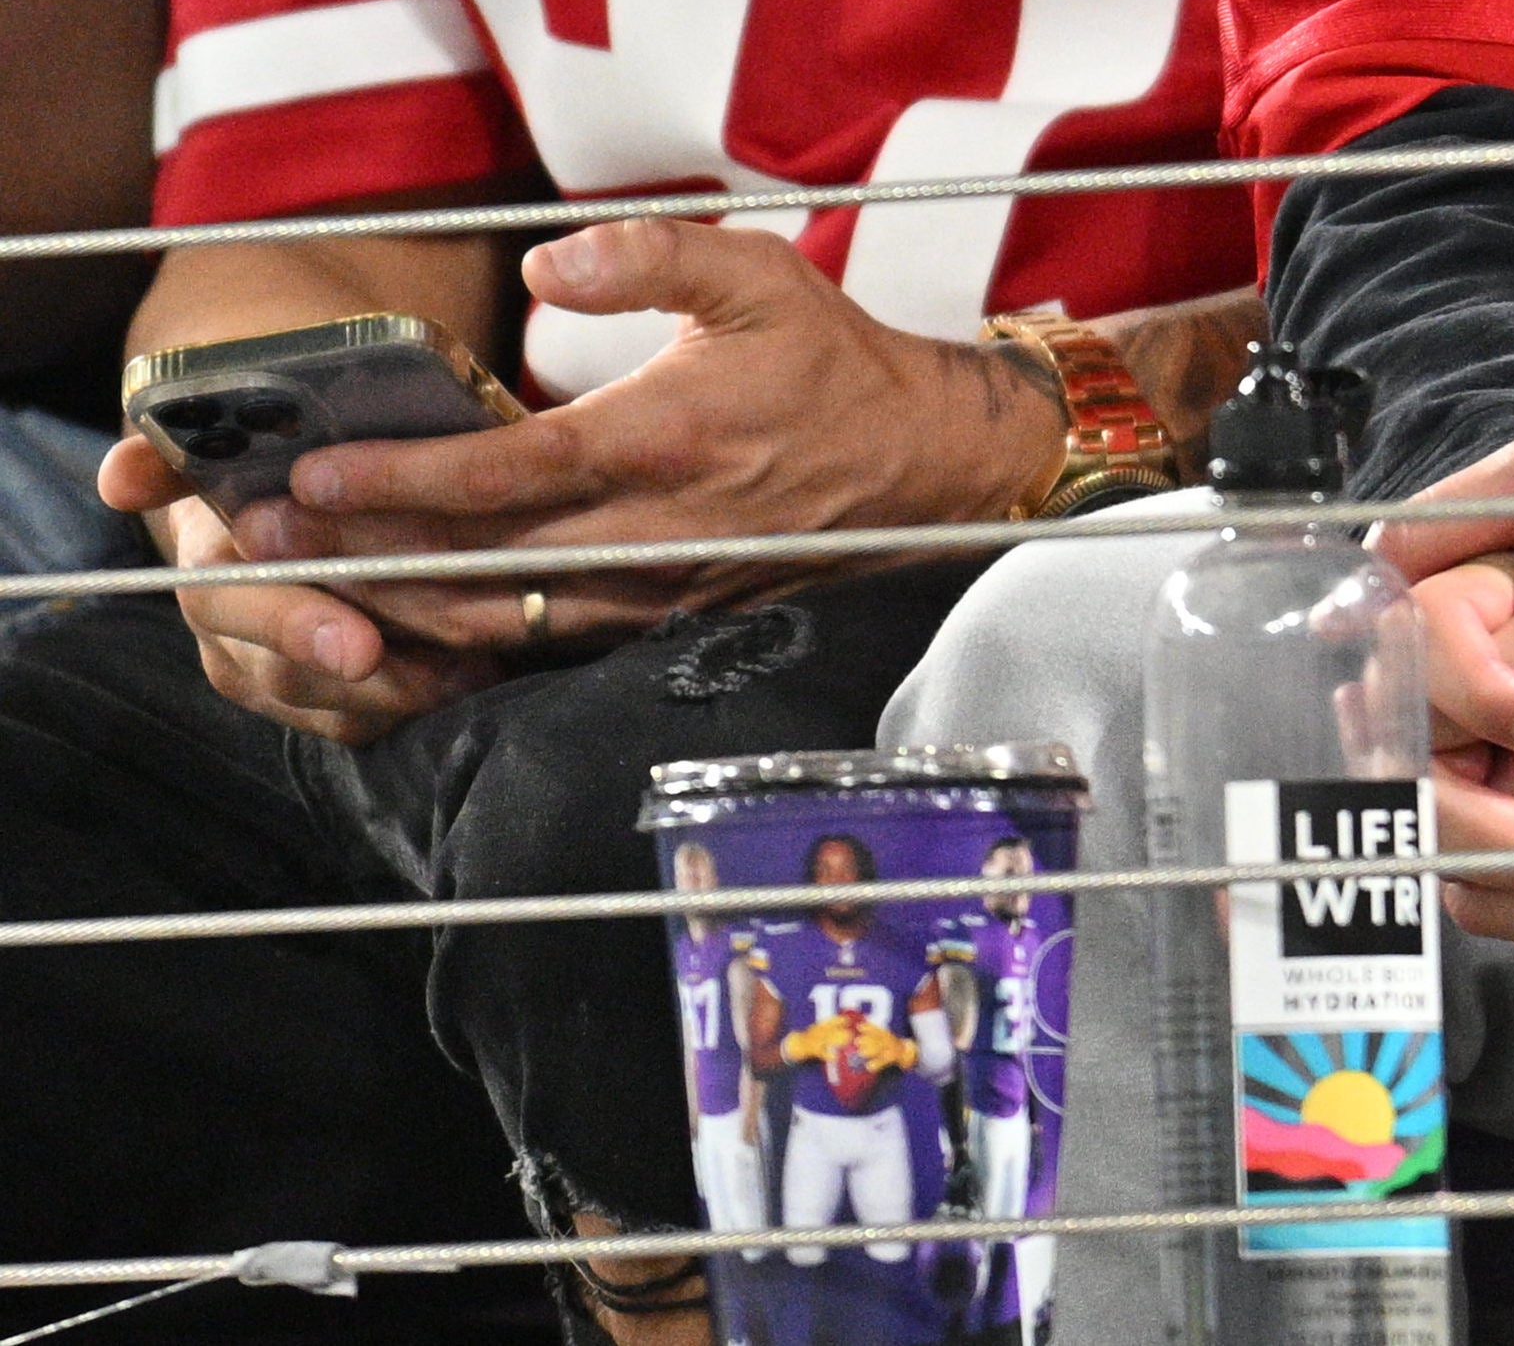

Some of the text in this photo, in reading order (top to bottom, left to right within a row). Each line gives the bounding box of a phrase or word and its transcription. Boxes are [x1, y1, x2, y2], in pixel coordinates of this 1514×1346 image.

[1294, 808, 1420, 859] LIFE
[1293, 875, 1422, 928] WTR
[1282, 965, 1374, 984] WHOLE
